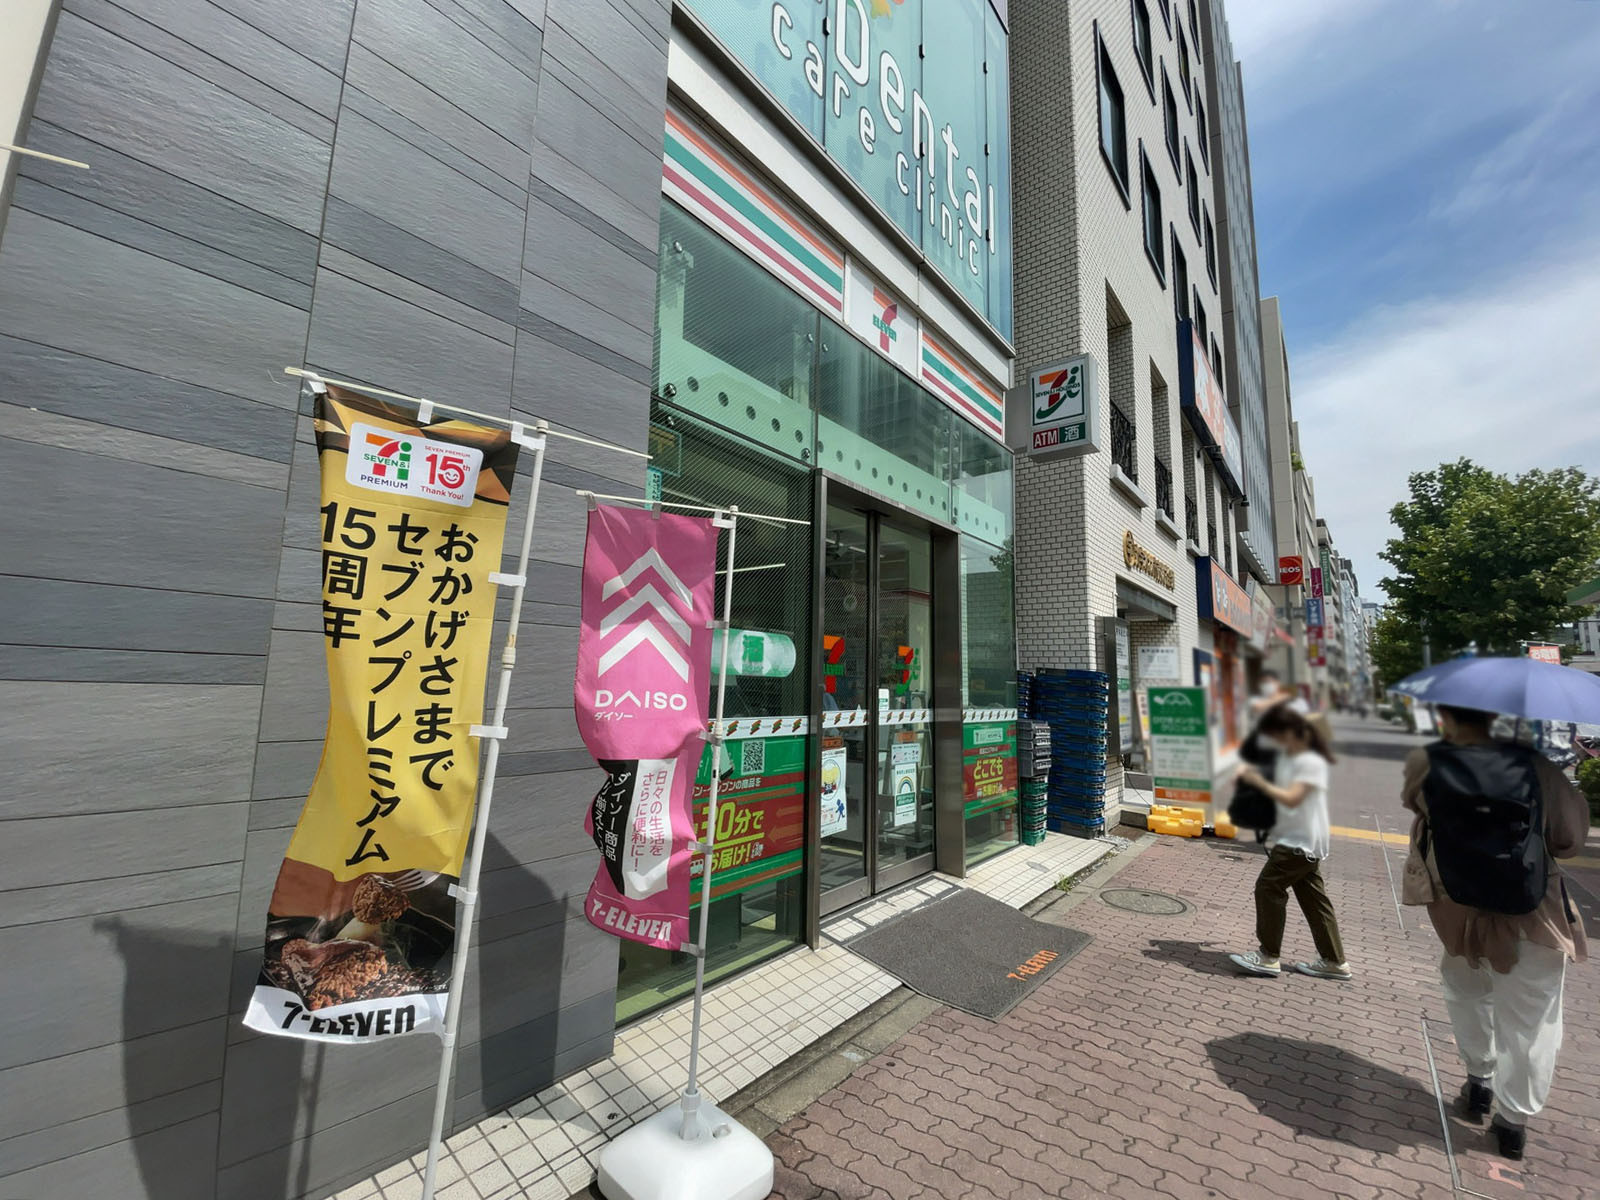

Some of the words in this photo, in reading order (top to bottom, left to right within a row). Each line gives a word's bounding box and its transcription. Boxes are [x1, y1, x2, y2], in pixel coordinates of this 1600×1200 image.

[771, 2, 876, 154] care
[896, 151, 979, 276] clinic
[1034, 430, 1058, 448] ATM
[1064, 424, 1080, 442] 酒
[424, 444, 444, 454] SEVEN
[444, 449, 471, 459] PREMIUM
[360, 474, 408, 490] PREMIUM
[420, 485, 446, 498] Thank
[447, 489, 465, 501] You!
[320, 501, 377, 649] 15周年
[409, 523, 479, 791] おかげさまで
[345, 512, 430, 868] セブンプレミアム
[594, 689, 688, 712] DAISO
[594, 711, 634, 721] ダイソー
[973, 756, 1004, 780] どこでも
[604, 771, 632, 862] ダイソー商品
[648, 770, 671, 857] 日々の生活を
